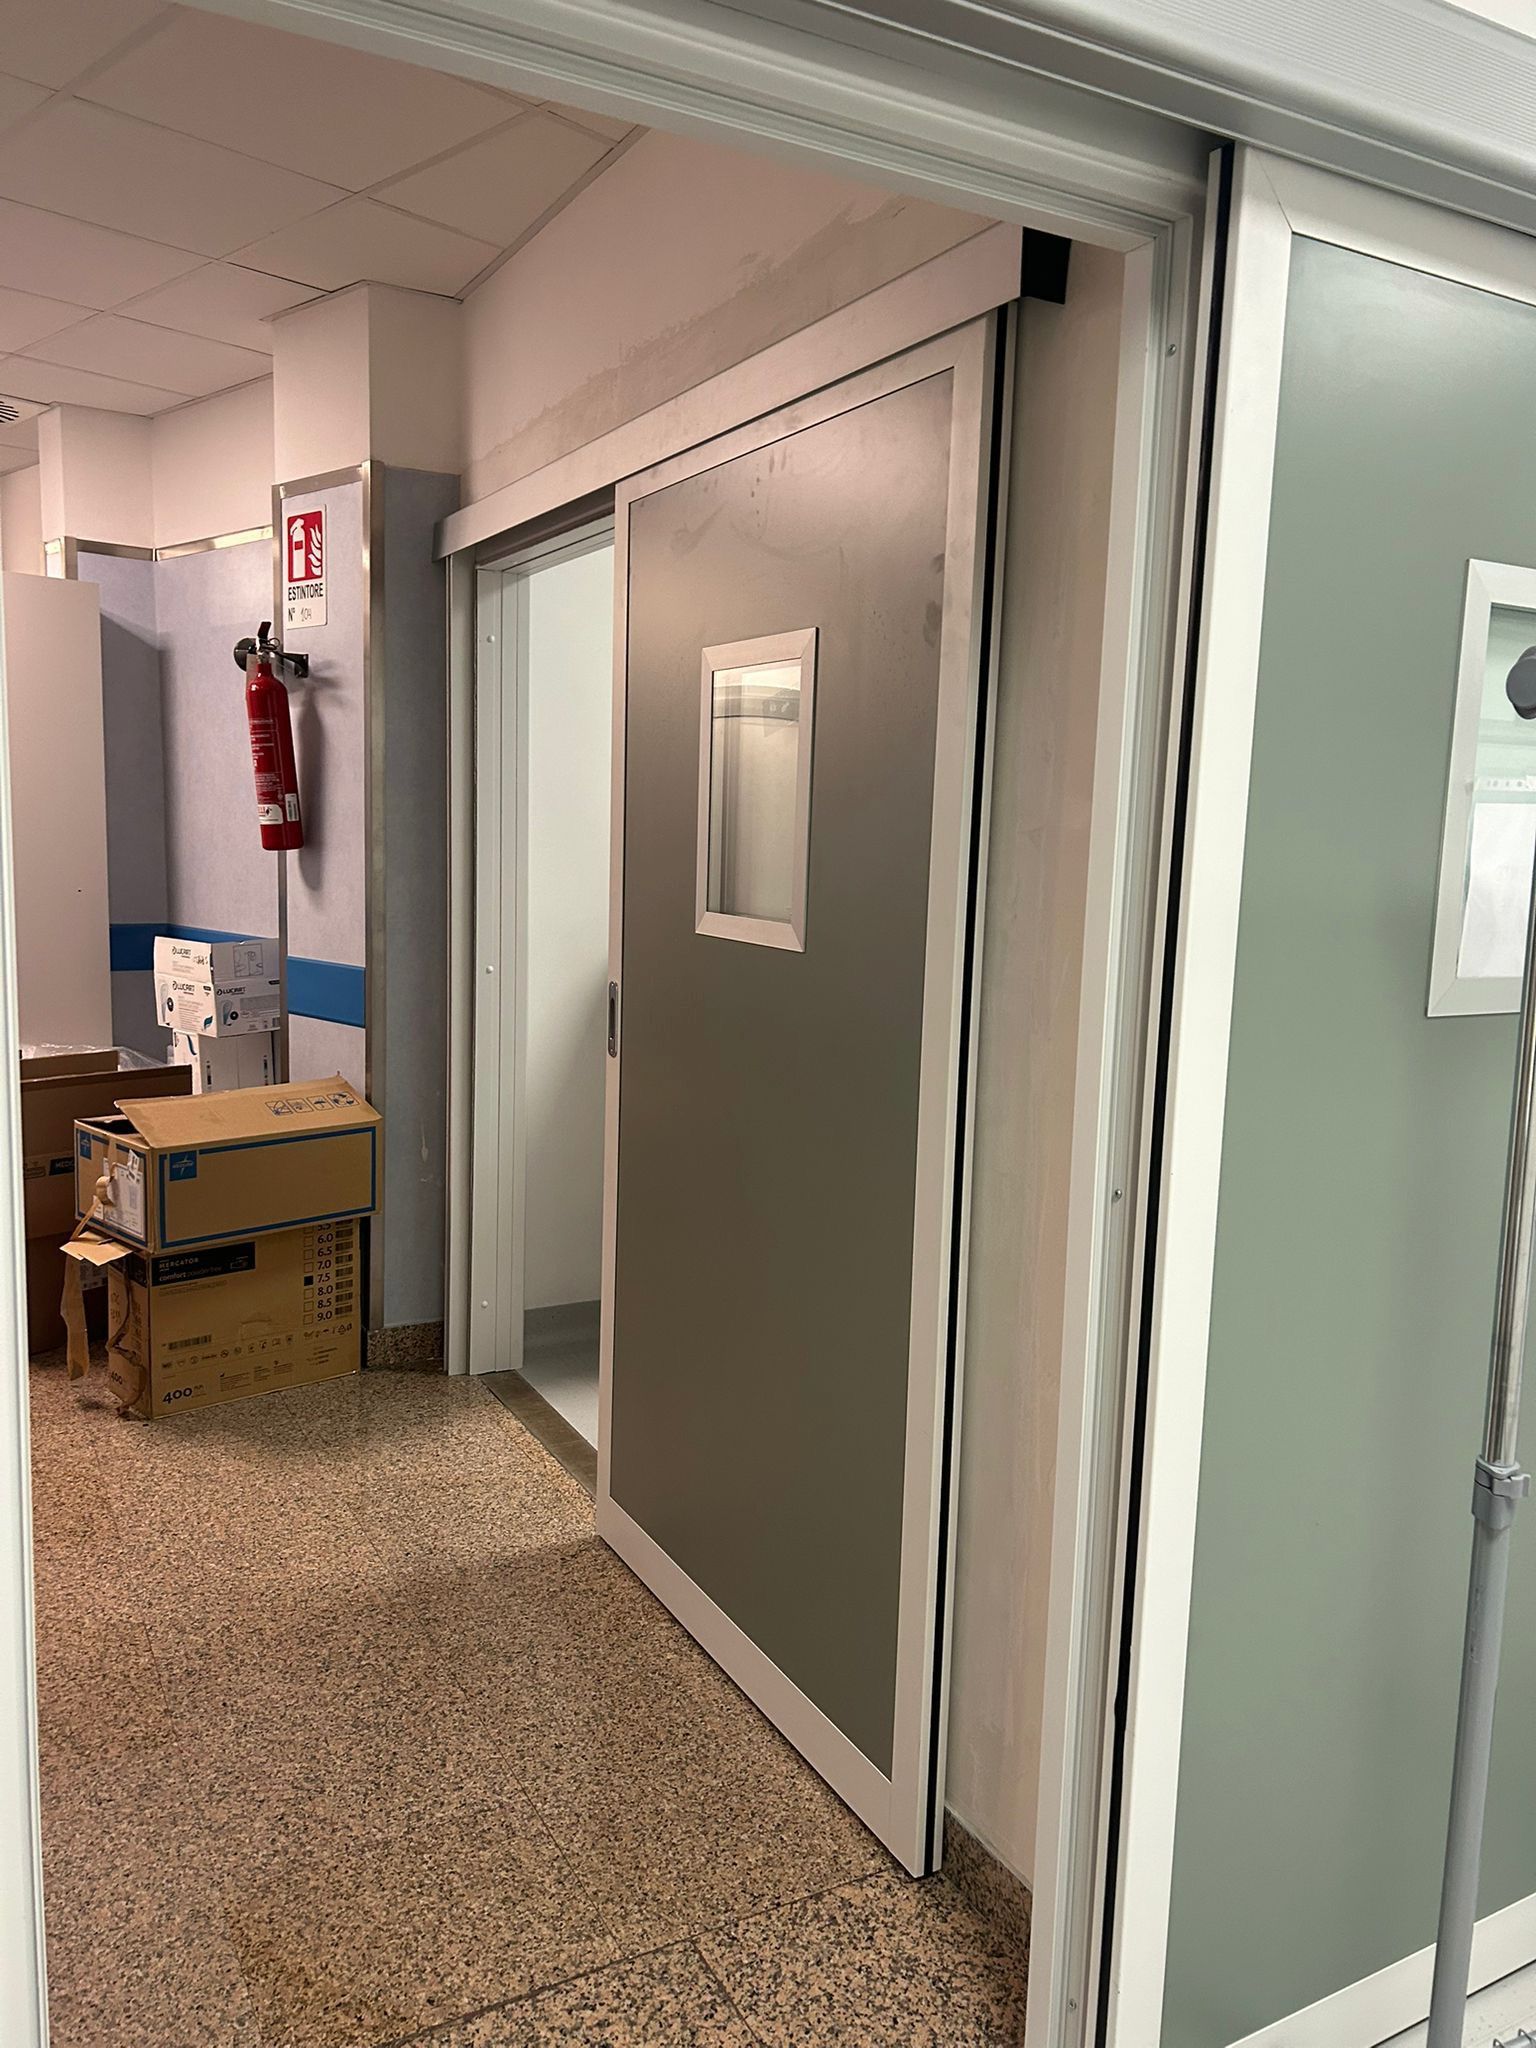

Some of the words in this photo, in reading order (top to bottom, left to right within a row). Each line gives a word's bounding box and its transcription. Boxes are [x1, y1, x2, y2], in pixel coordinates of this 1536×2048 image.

[288, 582, 323, 601] ESTINTORE
[222, 986, 246, 995] LUCART
[317, 1233, 334, 1244] 6.0
[317, 1246, 333, 1257] 6.5
[159, 1257, 199, 1269] MERCATOR
[317, 1259, 332, 1270] 7.0
[159, 1271, 187, 1282] comfort
[317, 1272, 331, 1283] 7.5
[317, 1285, 334, 1296] 8.0
[317, 1298, 332, 1309] 8.5
[317, 1311, 333, 1322] 9.0
[162, 1387, 193, 1404] 400
